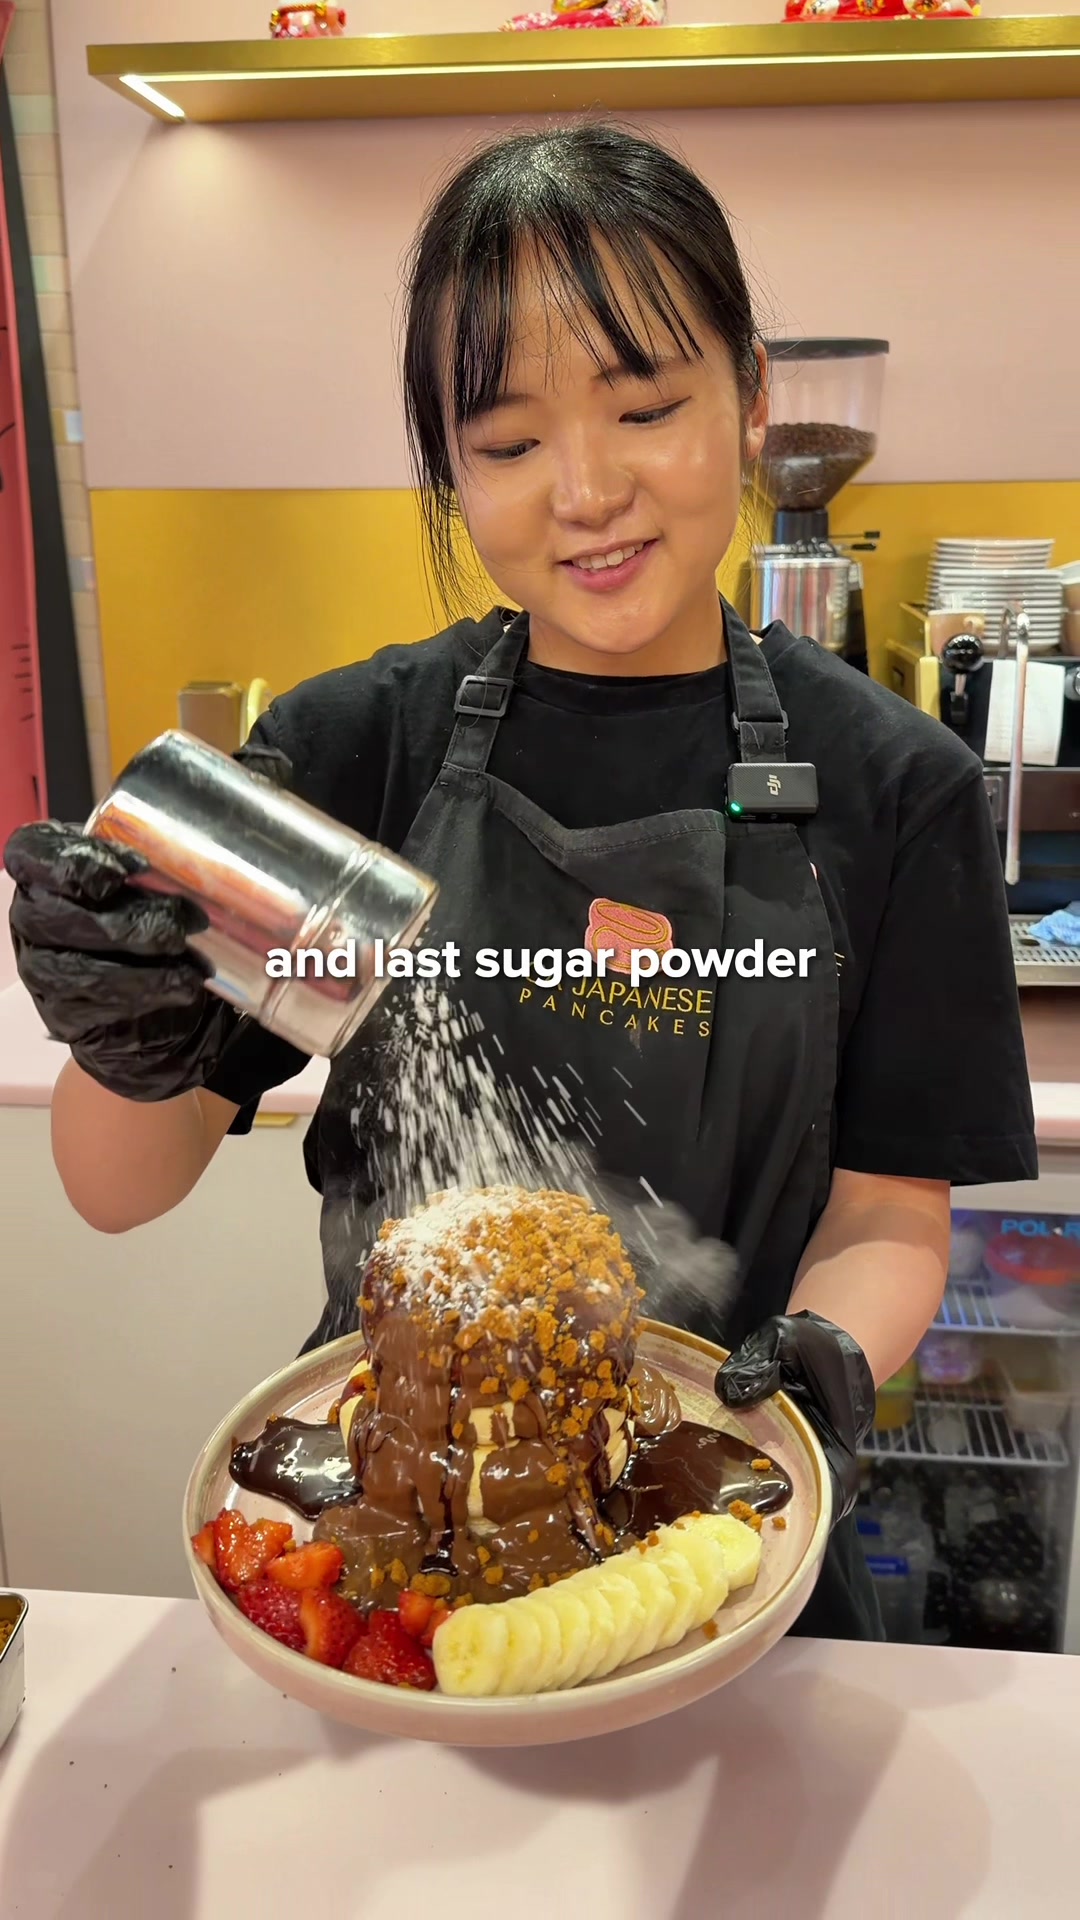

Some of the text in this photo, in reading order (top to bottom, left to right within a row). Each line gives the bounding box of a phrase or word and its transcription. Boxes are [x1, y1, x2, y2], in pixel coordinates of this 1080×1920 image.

[519, 987, 711, 1037] PANCAKES
[572, 975, 714, 1014] JAPANESE
[1000, 1218, 1080, 1240] POLR
